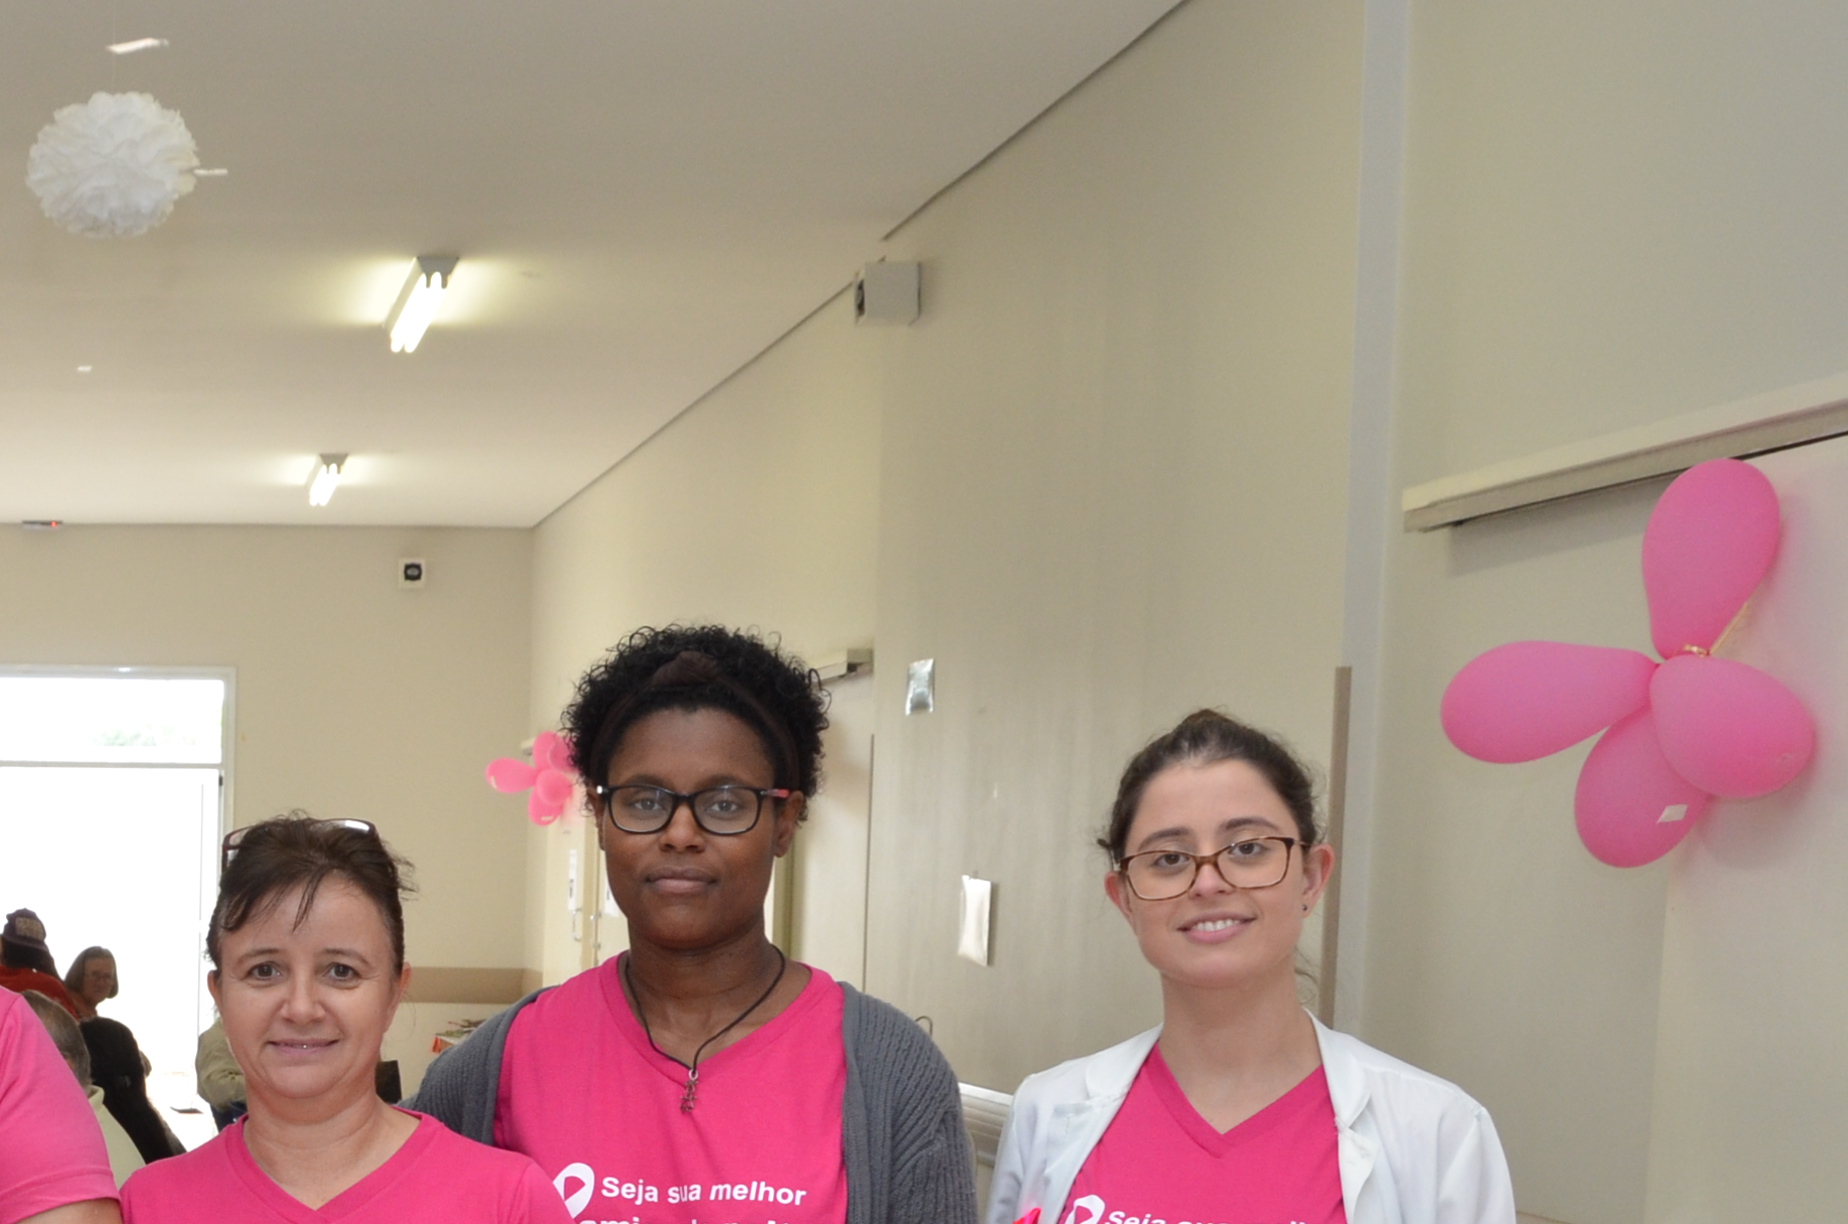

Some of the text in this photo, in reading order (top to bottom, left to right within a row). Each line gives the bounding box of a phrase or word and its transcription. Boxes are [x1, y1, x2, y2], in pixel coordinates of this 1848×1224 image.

[602, 1177, 806, 1205] Seja sua melhor
